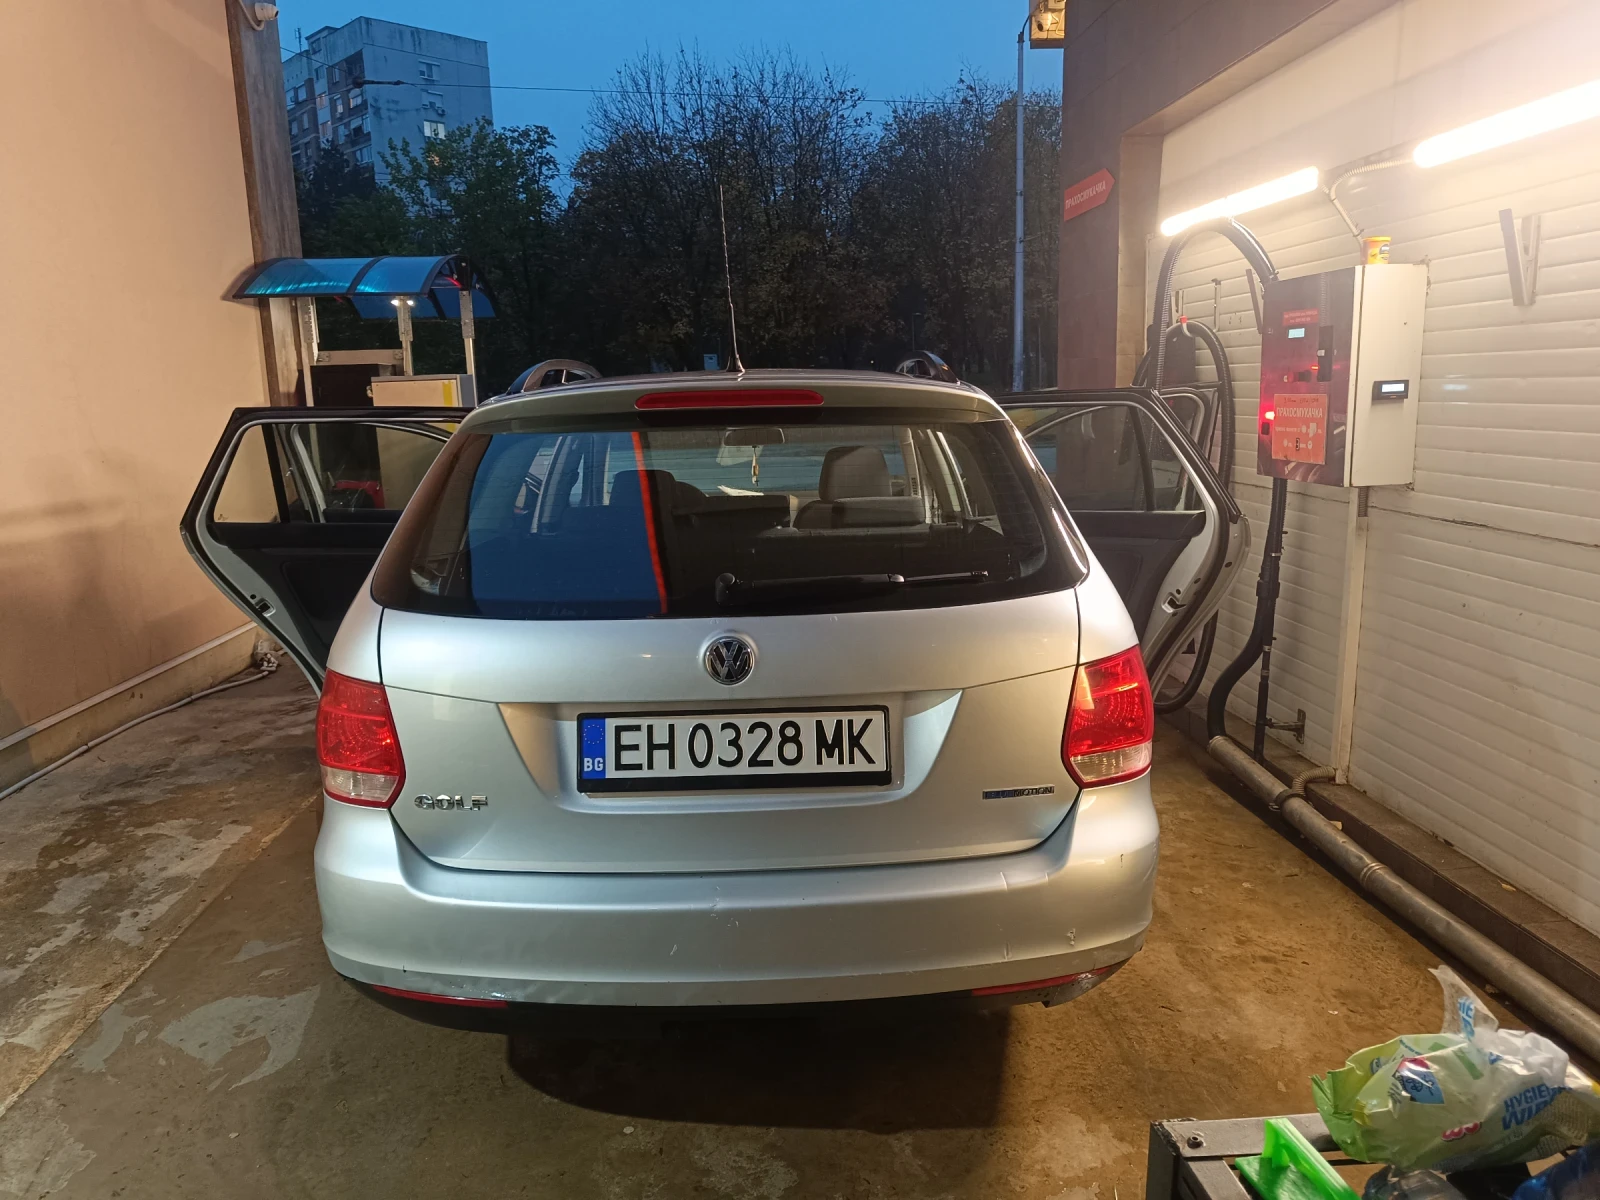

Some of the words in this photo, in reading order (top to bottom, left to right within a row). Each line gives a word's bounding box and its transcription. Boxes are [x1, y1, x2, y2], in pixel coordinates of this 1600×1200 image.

[1065, 180, 1106, 210] ПРАХОСМУКАЧКА
[1276, 407, 1323, 418] ПРАХОСМУКАЧКА
[614, 723, 677, 771] EH
[687, 720, 805, 769] 0328
[815, 718, 877, 766] MK
[583, 757, 604, 772] BG
[414, 793, 488, 811] GOLF
